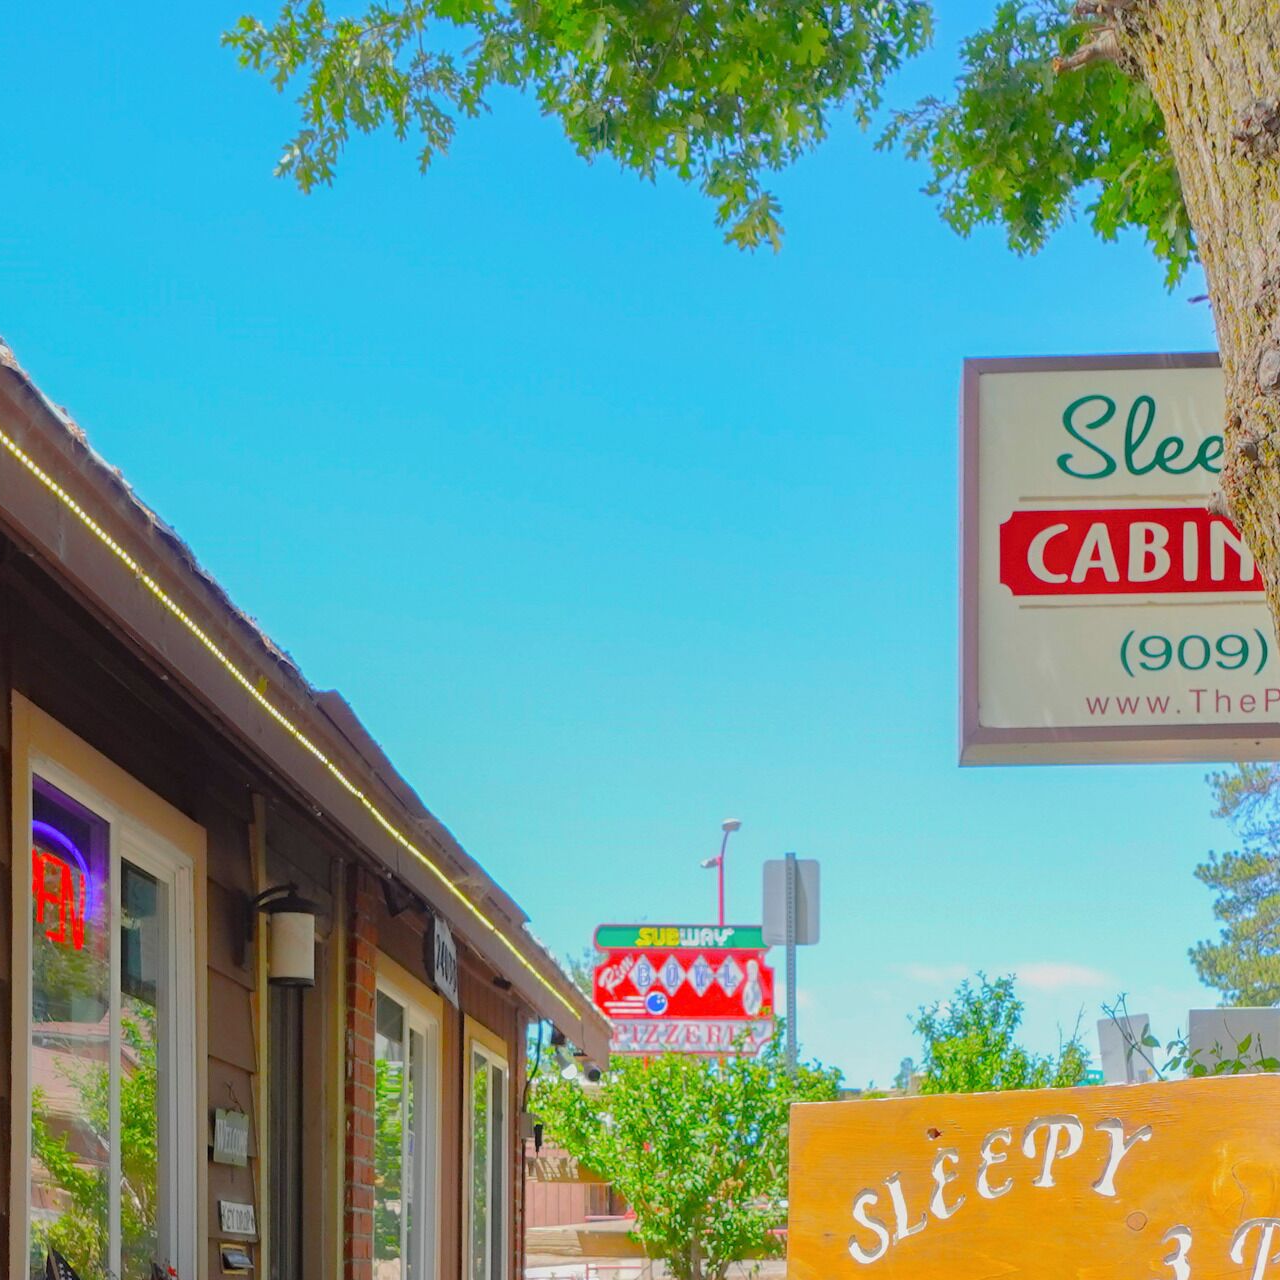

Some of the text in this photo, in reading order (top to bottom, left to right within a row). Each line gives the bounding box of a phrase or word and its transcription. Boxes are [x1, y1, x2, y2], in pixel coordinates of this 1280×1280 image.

[1056, 393, 1224, 480] Slee
[1026, 520, 1255, 585] CABIN
[1120, 629, 1269, 678] (909)
[634, 926, 735, 947] SUBWAY
[637, 963, 737, 988] BOWL
[848, 1112, 1153, 1265] SLEEPY
